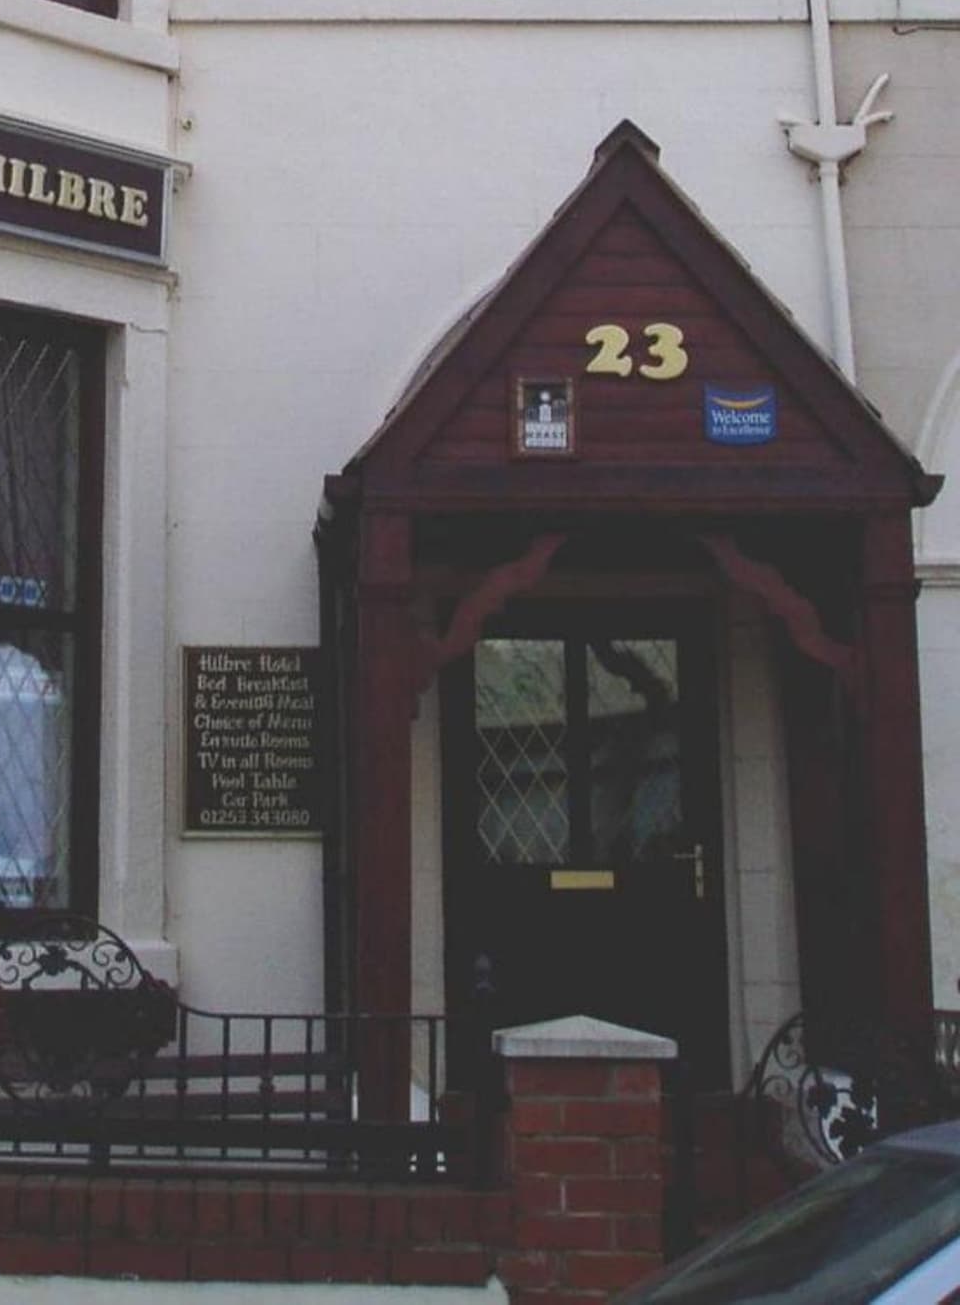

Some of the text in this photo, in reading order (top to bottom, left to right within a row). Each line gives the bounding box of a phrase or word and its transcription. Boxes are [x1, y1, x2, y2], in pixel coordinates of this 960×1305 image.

[585, 322, 689, 380] 23
[711, 409, 771, 425] Welcome
[199, 654, 301, 672] Hilbre Hotel
[196, 673, 226, 691] Bed
[248, 712, 264, 728] of
[197, 752, 220, 769] TV
[221, 753, 236, 769] in
[239, 752, 259, 769] all
[249, 772, 298, 790] Table
[251, 791, 289, 809] Park
